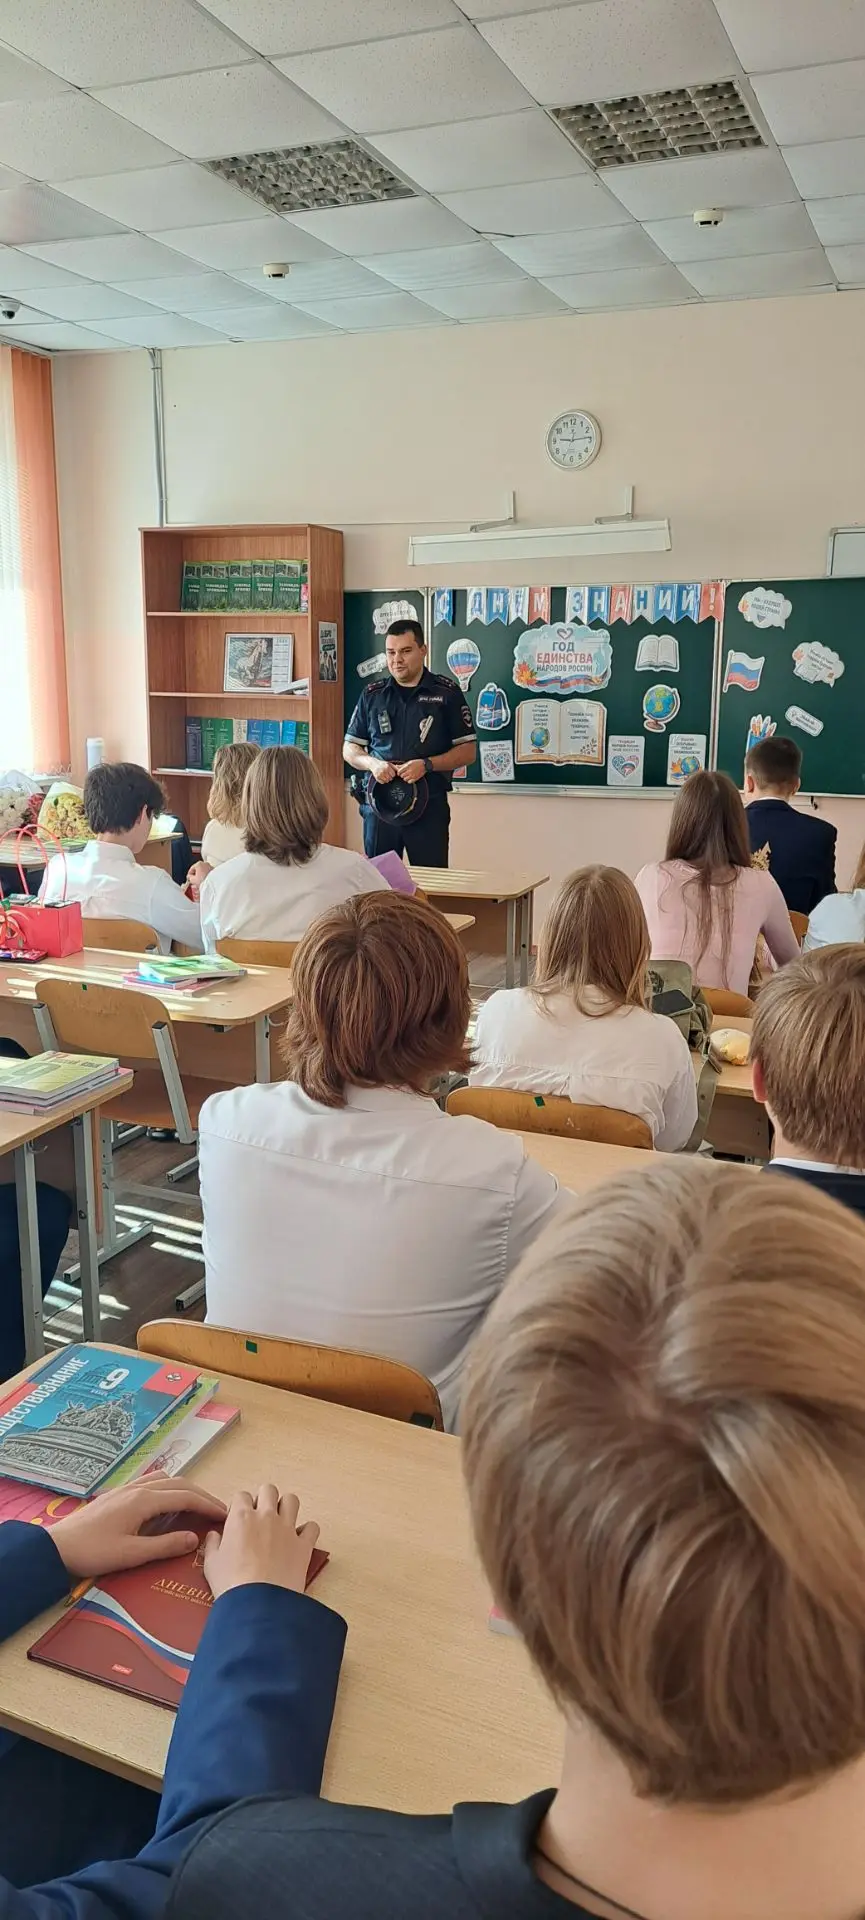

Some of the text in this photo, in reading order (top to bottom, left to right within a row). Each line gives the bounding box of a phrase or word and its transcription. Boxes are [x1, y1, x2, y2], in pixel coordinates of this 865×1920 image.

[572, 585, 716, 613] ЗНАНИЙ!
[552, 641, 575, 652] ГОД
[536, 652, 593, 664] ЕДИНСТВА
[536, 664, 593, 673] НАРОДОВ РОССИИ
[99, 1367, 130, 1390] 9
